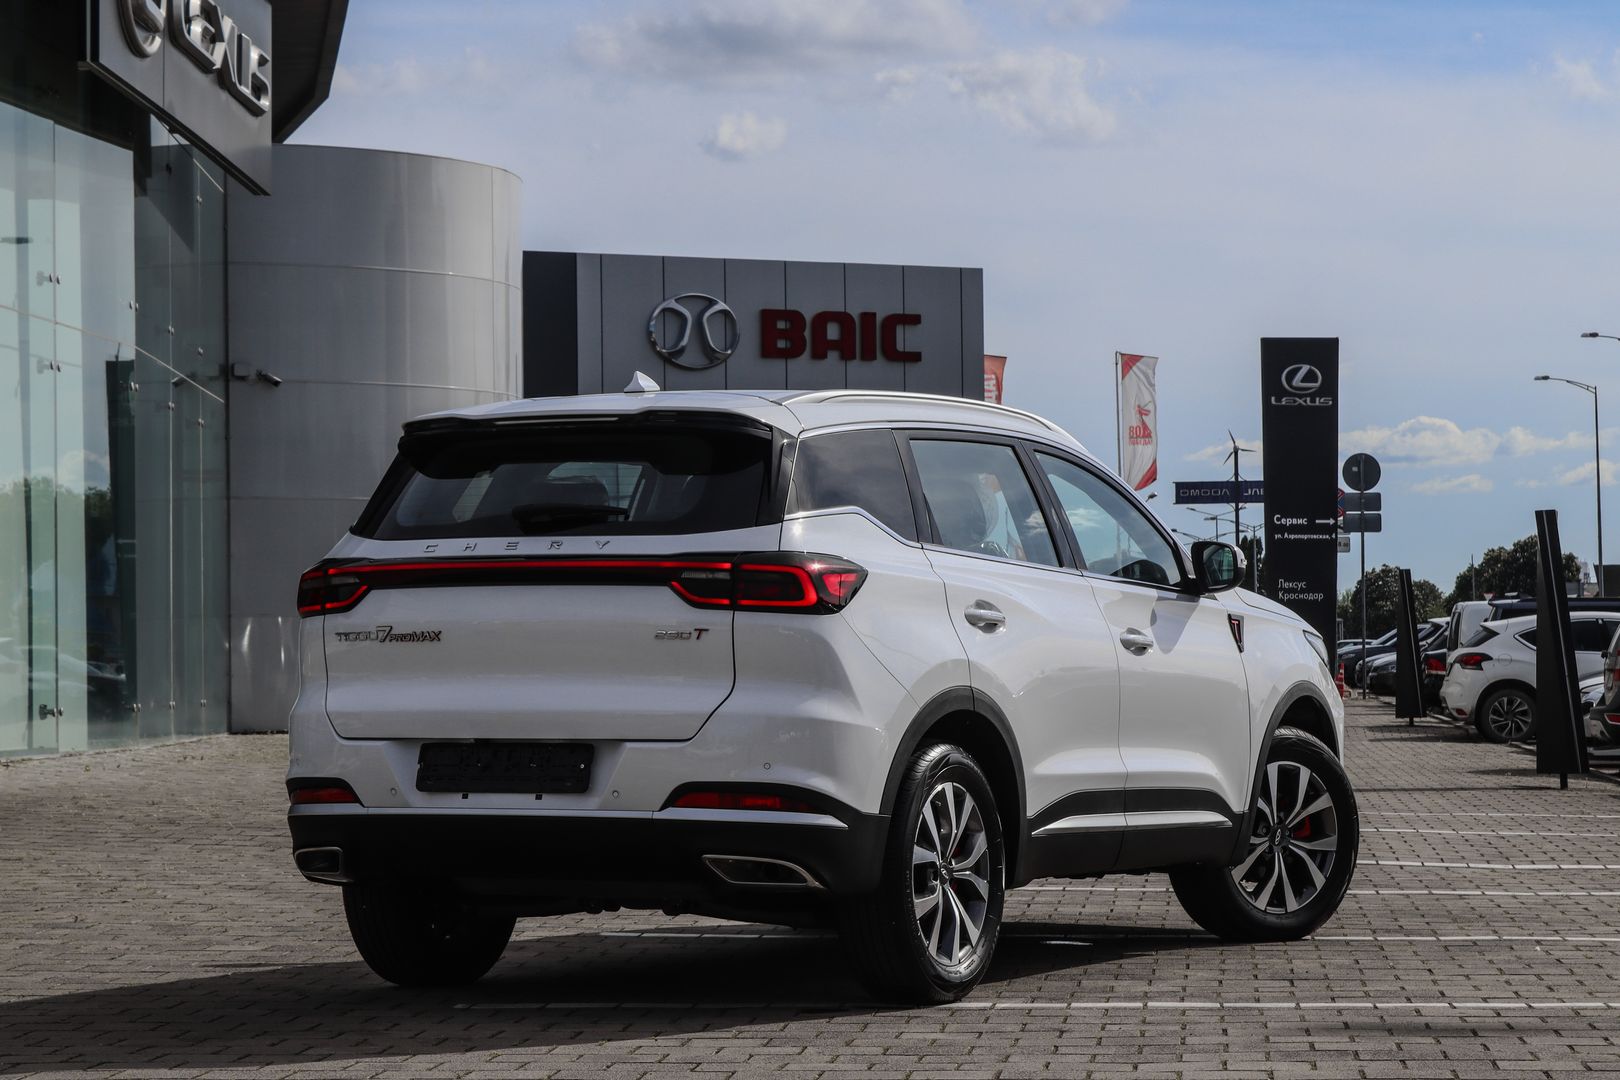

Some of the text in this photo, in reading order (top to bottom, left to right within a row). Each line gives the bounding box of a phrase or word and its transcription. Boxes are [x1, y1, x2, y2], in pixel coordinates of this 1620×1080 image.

[760, 308, 922, 362] BAIC
[1271, 396, 1333, 406] LEXUS
[1179, 488, 1230, 497] OMODA
[1273, 514, 1308, 526] Сервис
[423, 540, 611, 553] CHERY
[1278, 578, 1307, 591] Лексус
[1278, 590, 1324, 602] Краснодар
